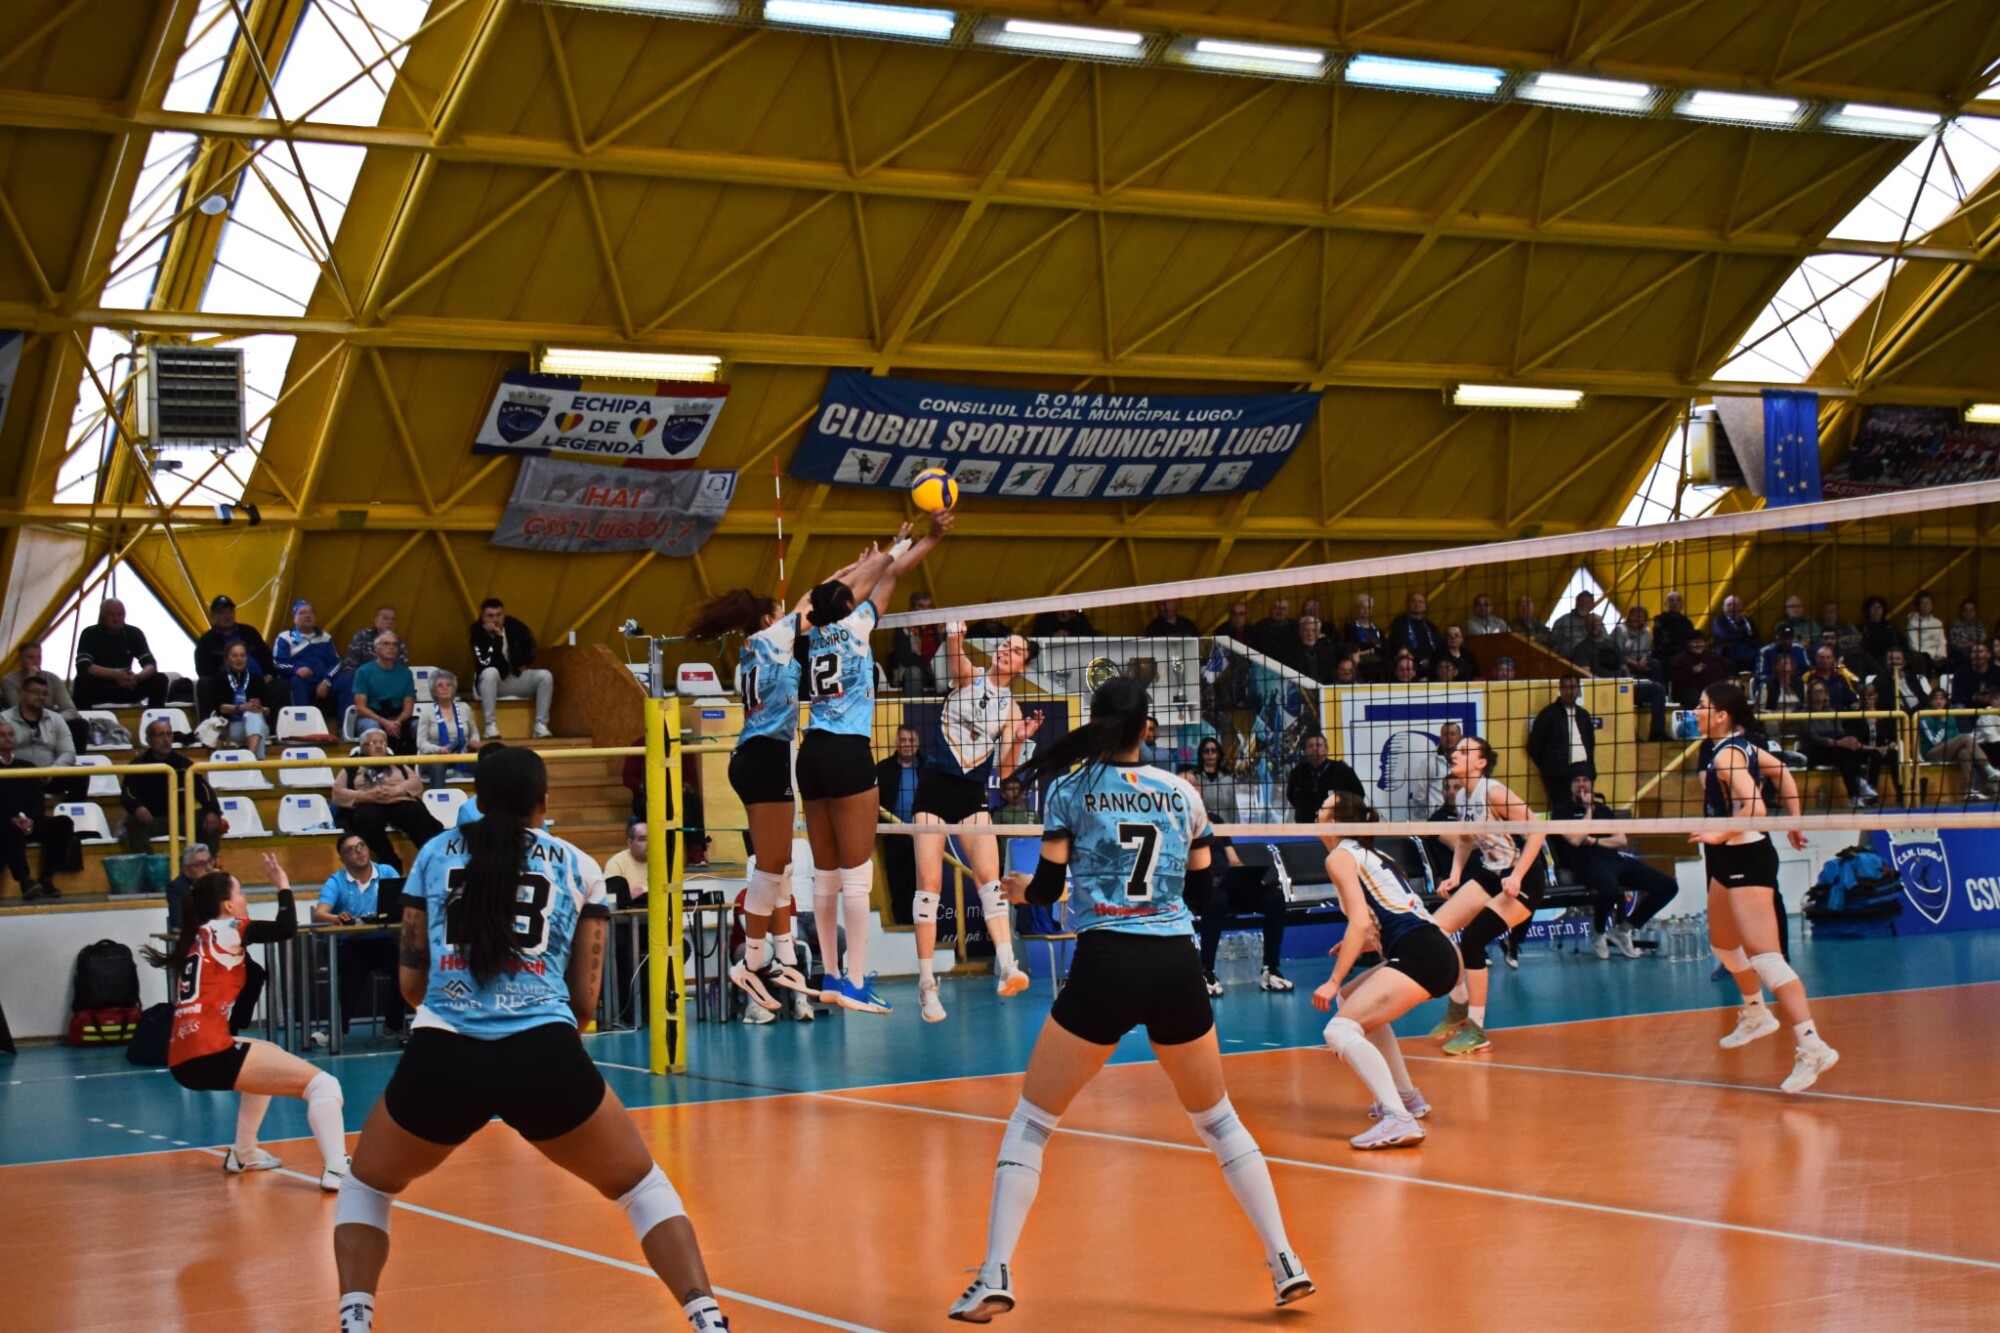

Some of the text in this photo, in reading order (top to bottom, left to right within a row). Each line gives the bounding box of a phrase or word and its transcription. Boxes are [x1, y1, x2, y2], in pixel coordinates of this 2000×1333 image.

[571, 396, 652, 415] ECHIPA
[919, 398, 1243, 422] CONSILIUL LOCAL MUNICIPAL LUGOJ
[588, 420, 620, 434] DE
[817, 403, 1303, 458] CLUBUL SPORTIV MUNICIPAL LUGOJ
[541, 437, 644, 455] LEGENDĂ
[583, 486, 643, 508] HAI
[523, 516, 569, 538] CSS
[1084, 787, 1184, 814] RANKOVIĆ
[1118, 823, 1162, 901] 7
